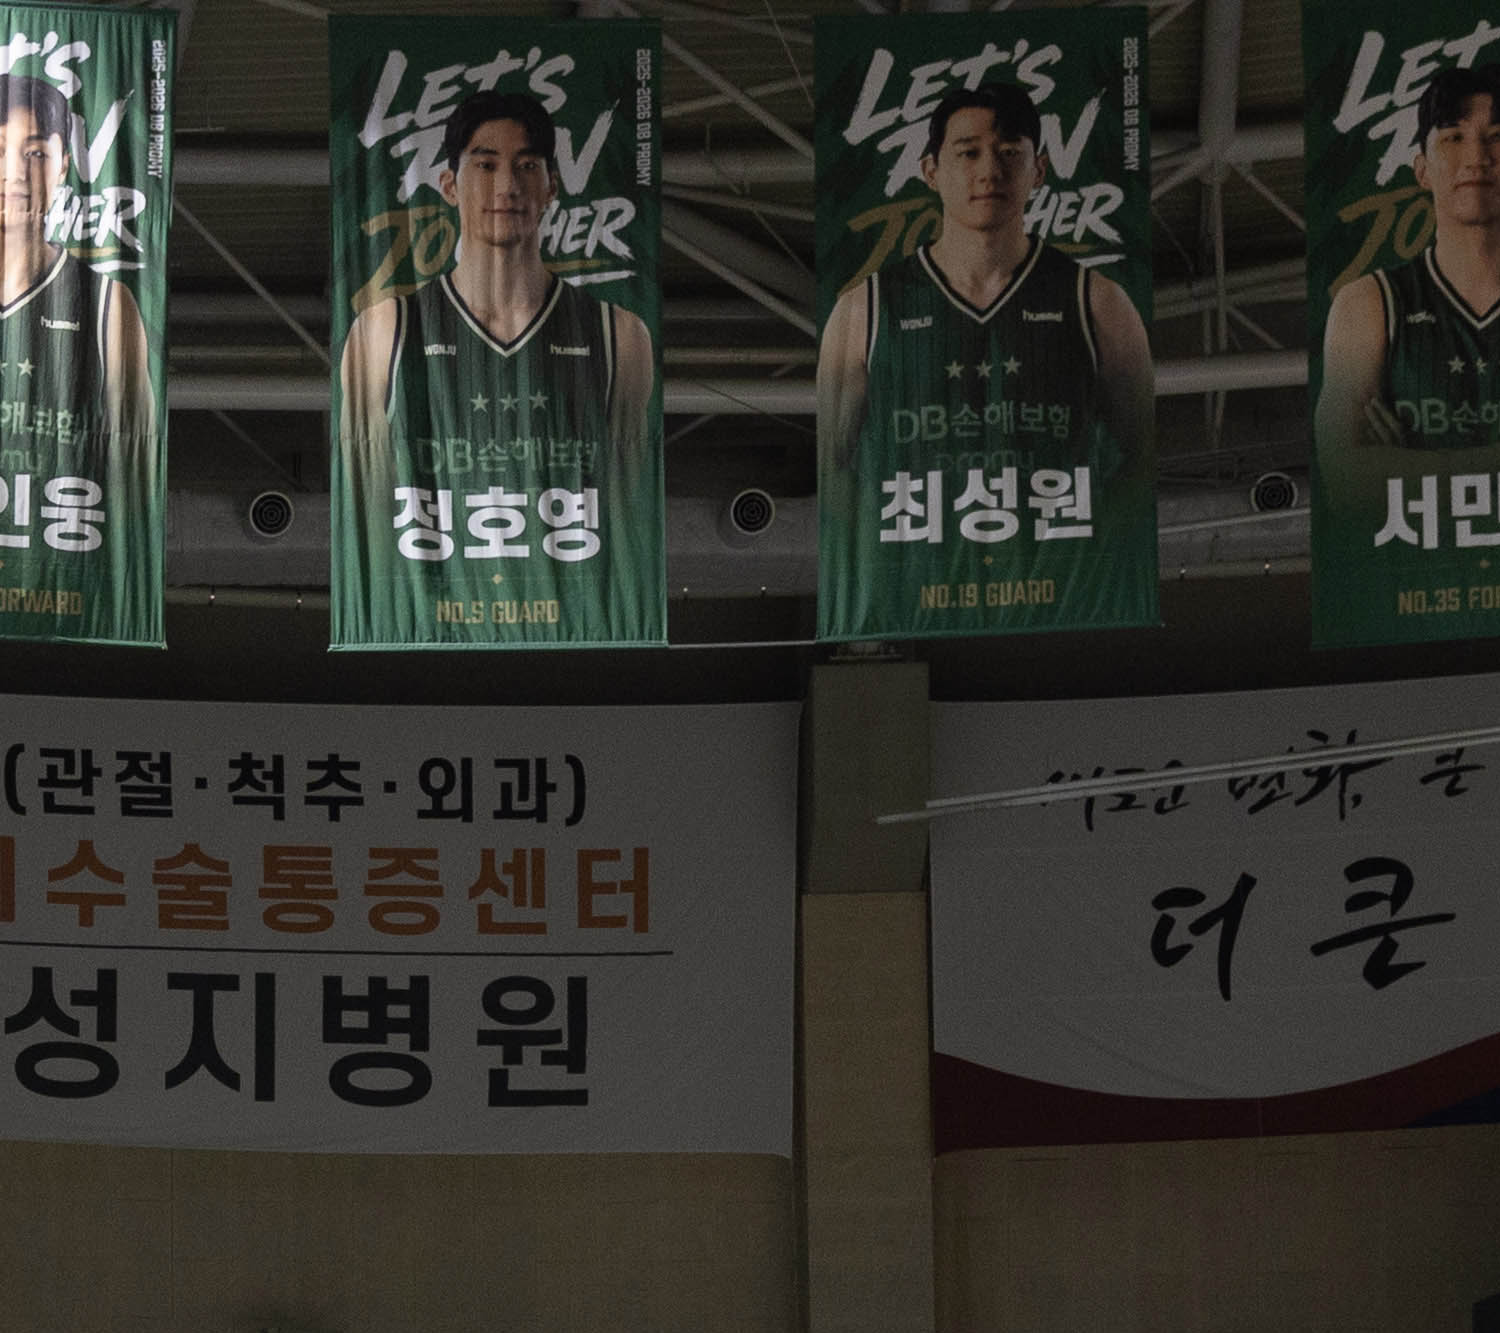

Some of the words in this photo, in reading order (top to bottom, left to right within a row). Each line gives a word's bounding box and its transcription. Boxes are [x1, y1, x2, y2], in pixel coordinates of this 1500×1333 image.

[393, 485, 601, 563] 정호영
[878, 465, 1096, 548] 최성원
[436, 599, 485, 626] NO.5
[492, 598, 561, 625] GUARD
[920, 584, 979, 611] NO.19
[985, 578, 1056, 608] GUARD
[1398, 588, 1461, 618] NO.35
[1150, 872, 1258, 1001] 더
[1309, 856, 1457, 991] 큰
[3, 965, 592, 1108] 성지병원
